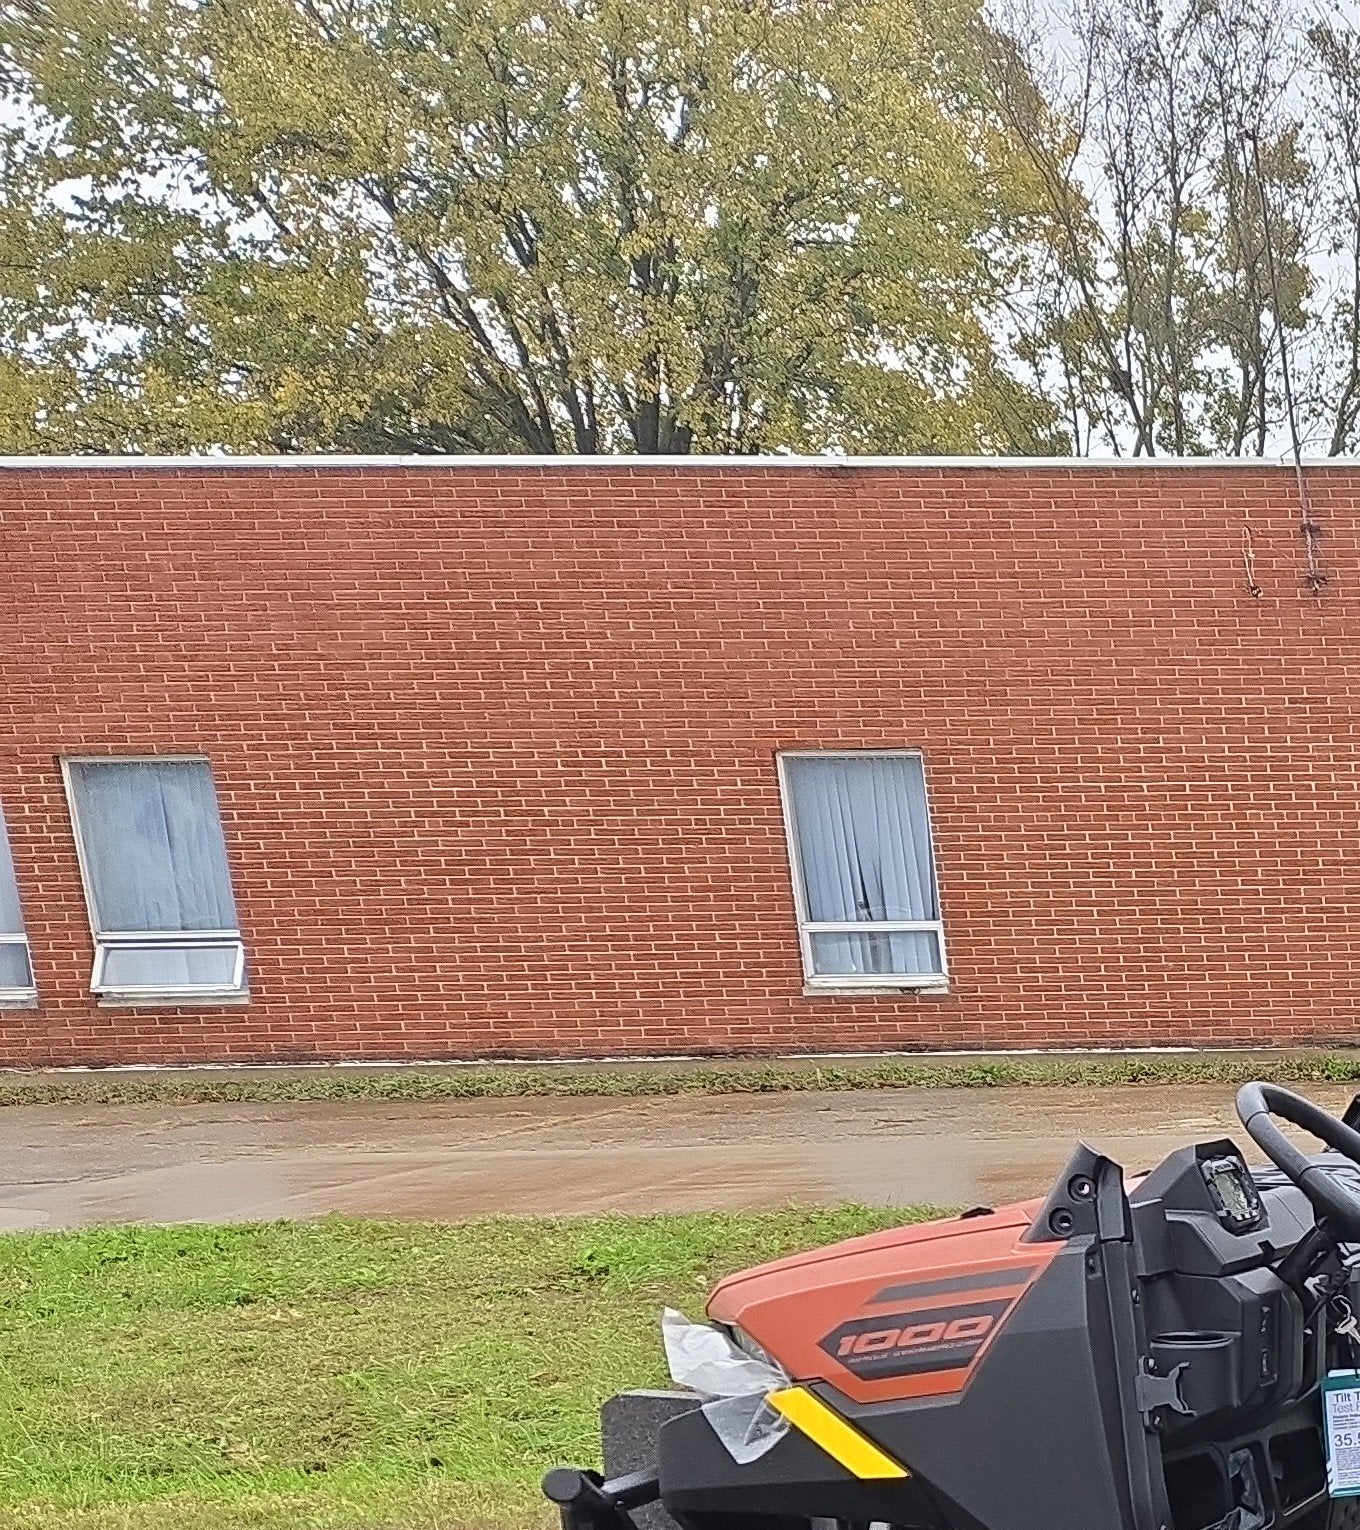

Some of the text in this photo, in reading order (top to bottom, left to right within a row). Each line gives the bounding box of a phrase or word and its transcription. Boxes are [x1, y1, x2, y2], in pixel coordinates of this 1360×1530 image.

[837, 1314, 994, 1356] 1000
[1333, 1393, 1352, 1403] Tilt
[1332, 1403, 1354, 1413] Test
